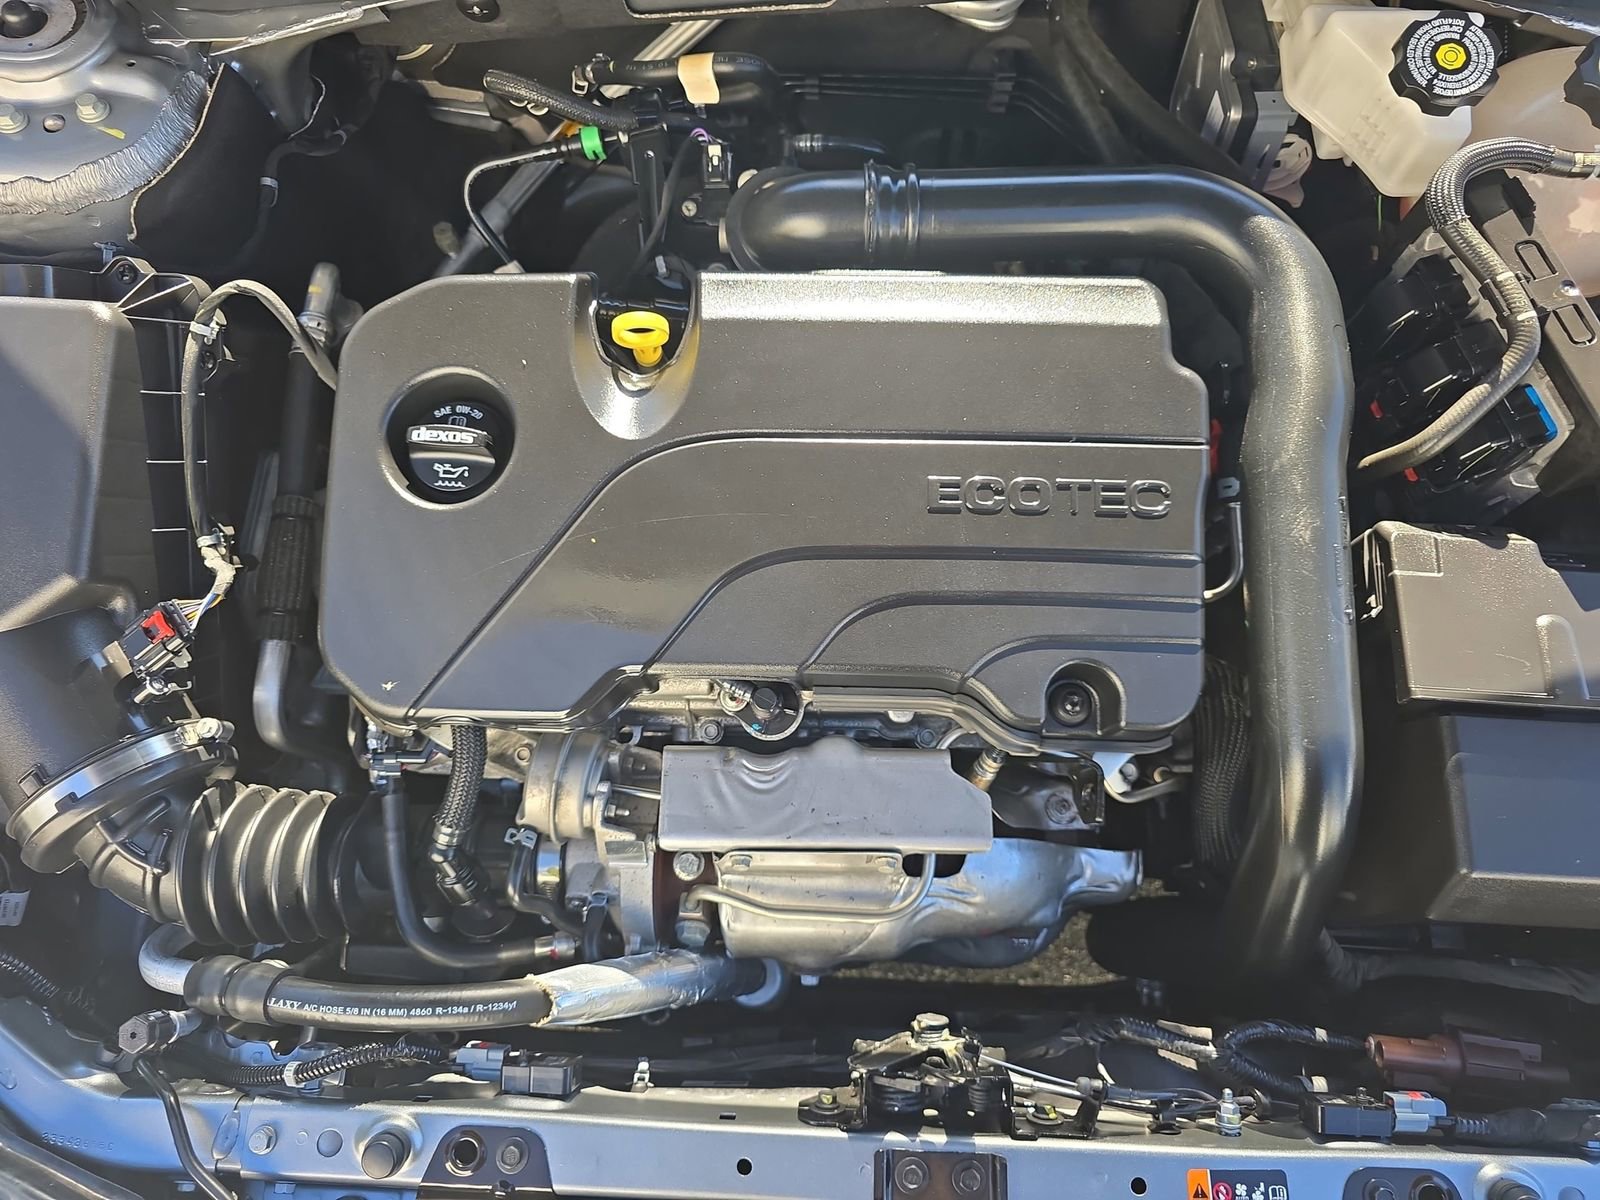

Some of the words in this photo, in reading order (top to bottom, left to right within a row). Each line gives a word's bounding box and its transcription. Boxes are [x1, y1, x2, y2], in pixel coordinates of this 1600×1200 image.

[1416, 22, 1433, 36] FROM
[1431, 18, 1448, 27] FLUID
[1450, 25, 1463, 33] CAP
[1428, 25, 1450, 37] BEFORE
[1406, 37, 1418, 57] SEALED
[1423, 40, 1435, 56] CLEAN
[1423, 57, 1437, 75] FILLER
[1418, 67, 1433, 81] ONLY
[434, 406, 452, 418] SAE
[455, 405, 484, 420] 0W-20
[411, 426, 478, 444] dexos
[927, 474, 1172, 520] ECOTEC
[303, 1004, 318, 1012] A/C
[320, 1005, 345, 1015] HOSE
[345, 1007, 359, 1015] 5/8
[372, 1008, 387, 1017] (16
[388, 1008, 408, 1018] MM)
[409, 1007, 433, 1016] 4860
[435, 1006, 469, 1015] R-134a
